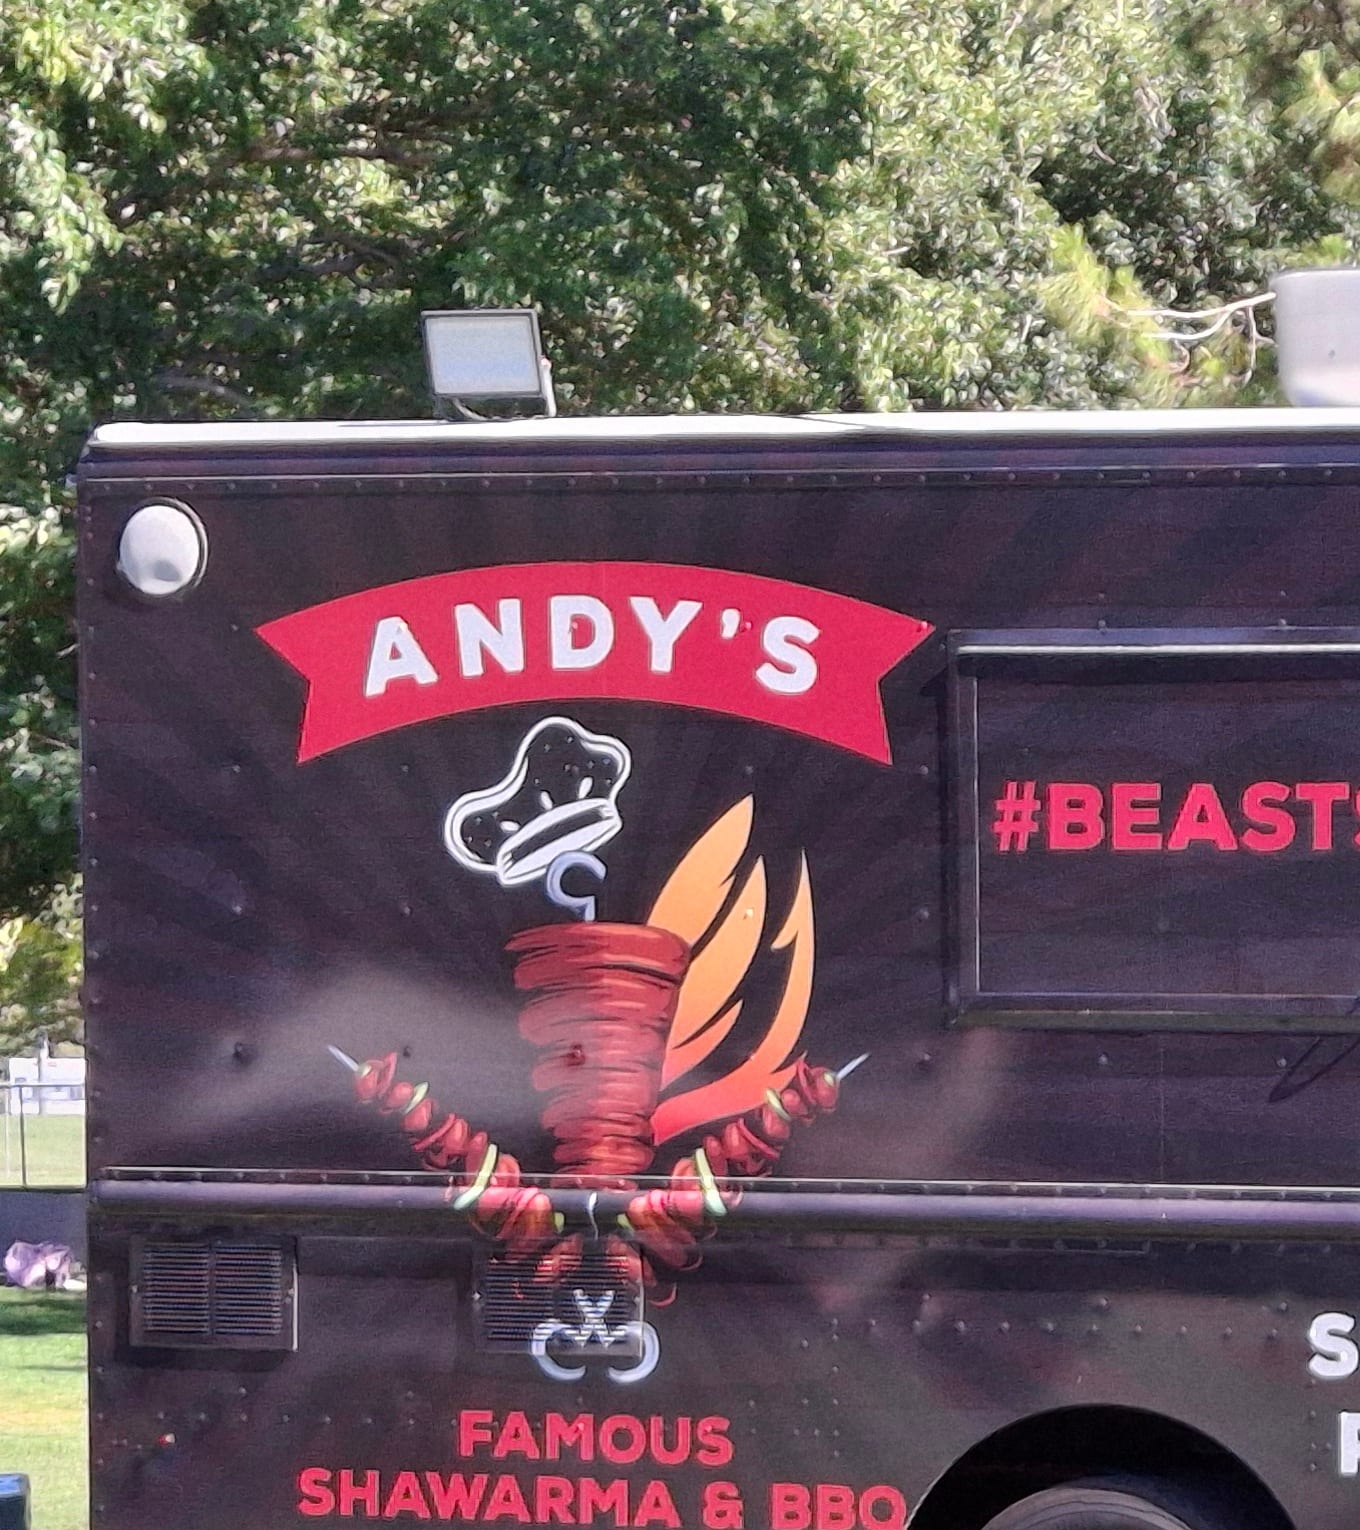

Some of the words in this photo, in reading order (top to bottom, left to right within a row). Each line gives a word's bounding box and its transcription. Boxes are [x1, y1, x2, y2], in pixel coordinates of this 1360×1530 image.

[363, 595, 820, 698] ANDY'S
[457, 1409, 735, 1466] FAMOUS
[297, 1466, 682, 1528] SHAWARMA
[701, 1480, 744, 1530] &
